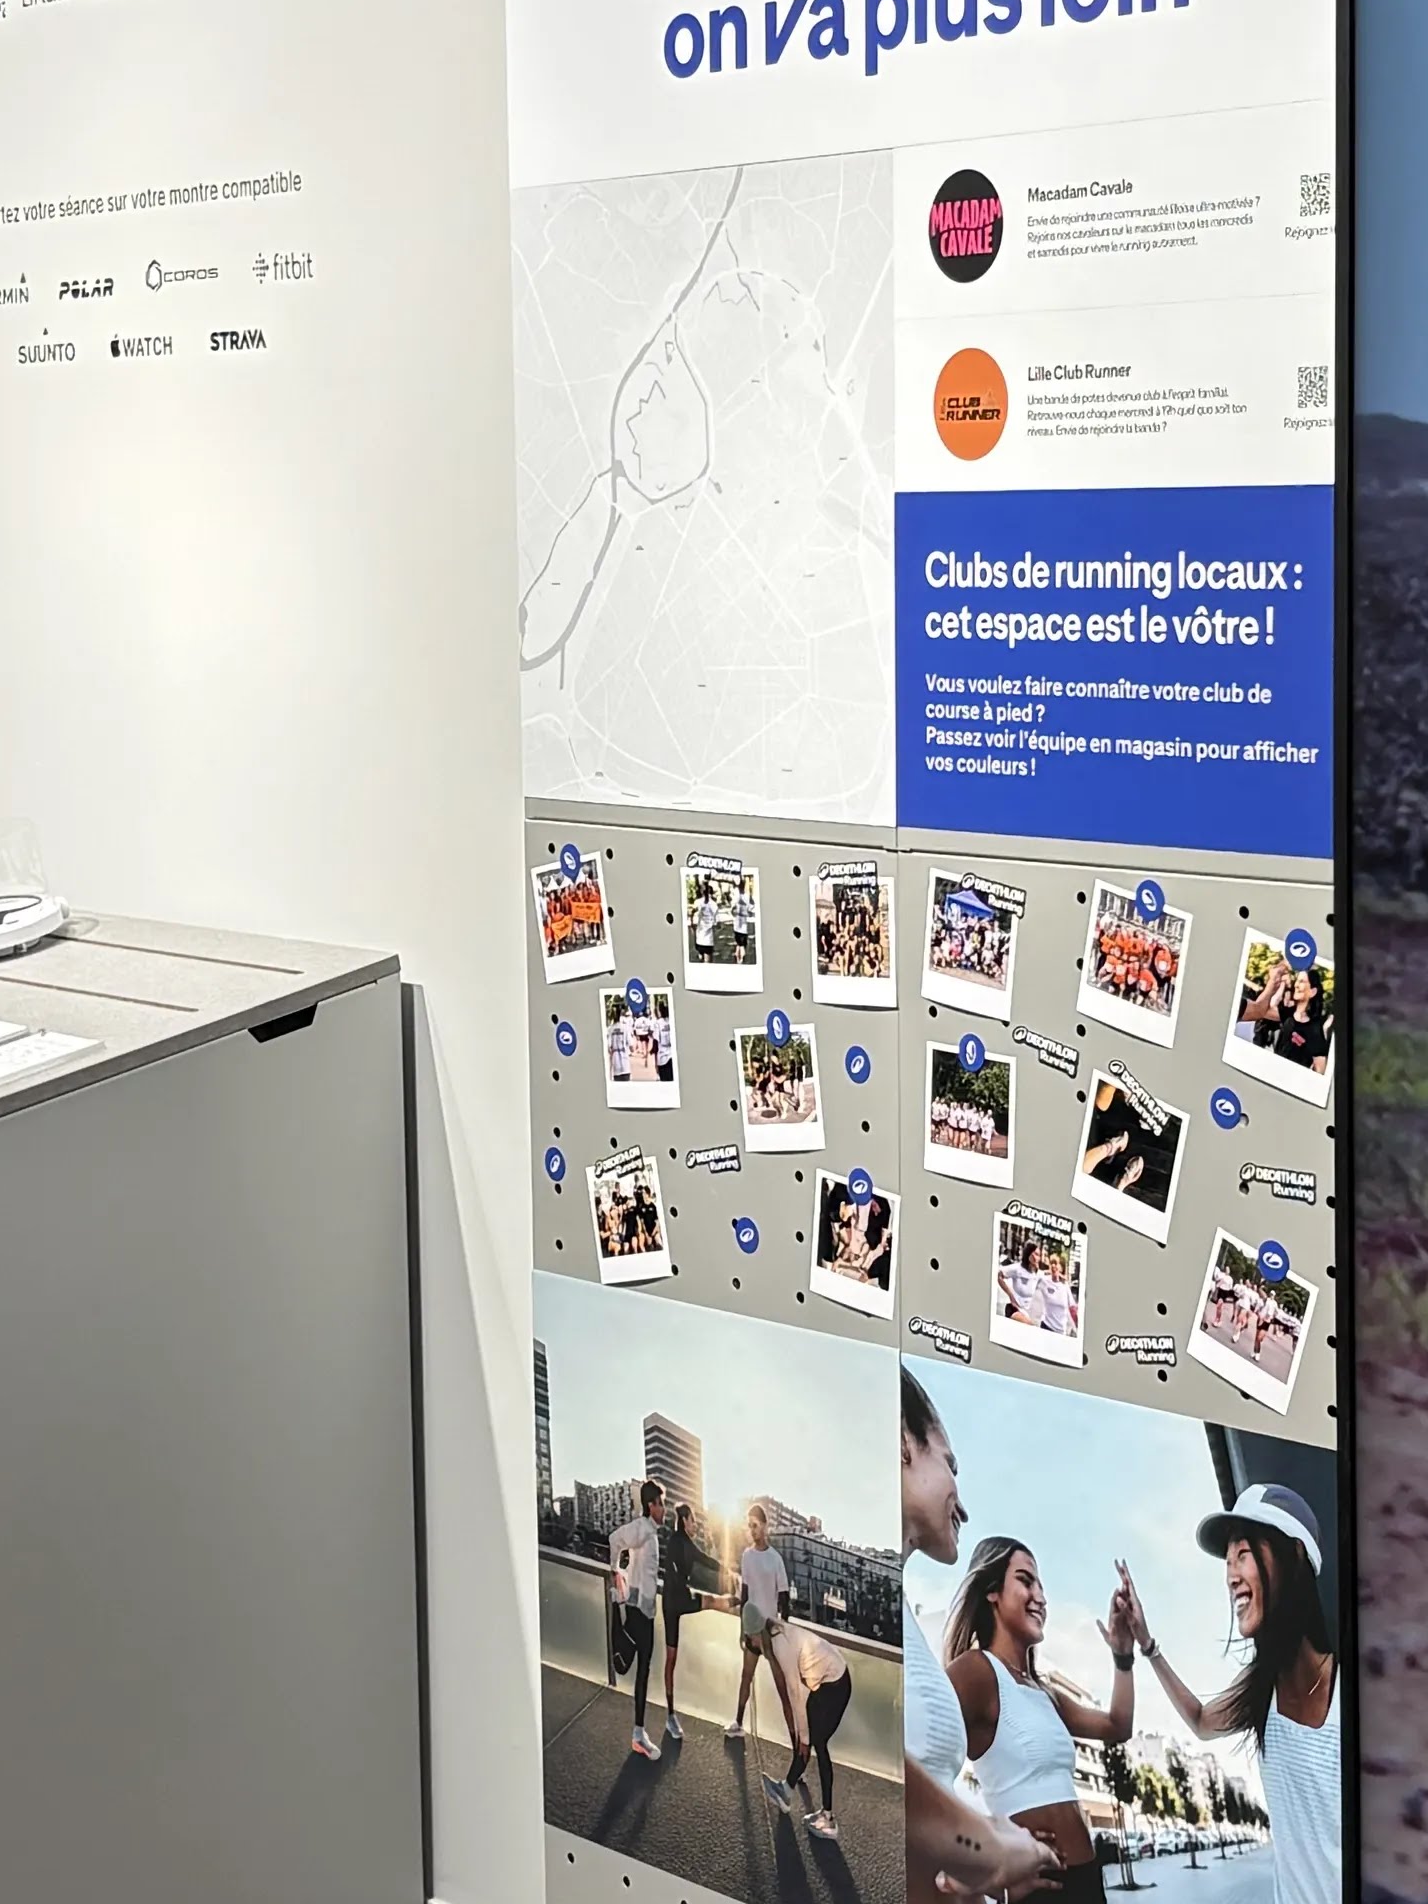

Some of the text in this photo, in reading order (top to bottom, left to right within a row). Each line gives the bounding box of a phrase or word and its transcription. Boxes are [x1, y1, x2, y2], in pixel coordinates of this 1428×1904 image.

[663, 4, 748, 80] on
[23, 201, 56, 221] votre
[59, 195, 104, 217] séance
[107, 194, 128, 213] sur
[131, 188, 166, 209] votre
[169, 183, 218, 205] montre
[222, 170, 302, 201] compatible
[1027, 178, 1133, 203] Macadam Cavale
[931, 198, 1001, 237] MACADAM
[940, 225, 993, 257] CAVALE
[59, 278, 114, 300] POLAR
[163, 268, 219, 283] COROS
[273, 252, 313, 280] fitbit
[18, 329, 267, 364] SUUNTO WATCH STRAVA
[1028, 363, 1131, 381] Lille Club Runner
[946, 409, 1000, 421] RUNNER
[947, 397, 980, 408] CLUB
[925, 550, 1303, 599] Clubs de running locaux :
[924, 605, 1274, 648] cet espace est le vôtre !
[925, 673, 1272, 704] Vous voulez faire connaître votre club de
[925, 700, 1045, 725] course à pied ?
[926, 726, 1319, 764] Passez voir l'équipe en magasin pour afficher
[925, 754, 1036, 776] vos couleurs !
[1026, 1031, 1077, 1061] DECATHLON
[1039, 1050, 1075, 1075] Running
[1255, 1167, 1314, 1187] DECATHLON
[1273, 1182, 1314, 1202] Running
[1137, 1350, 1175, 1364] Running
